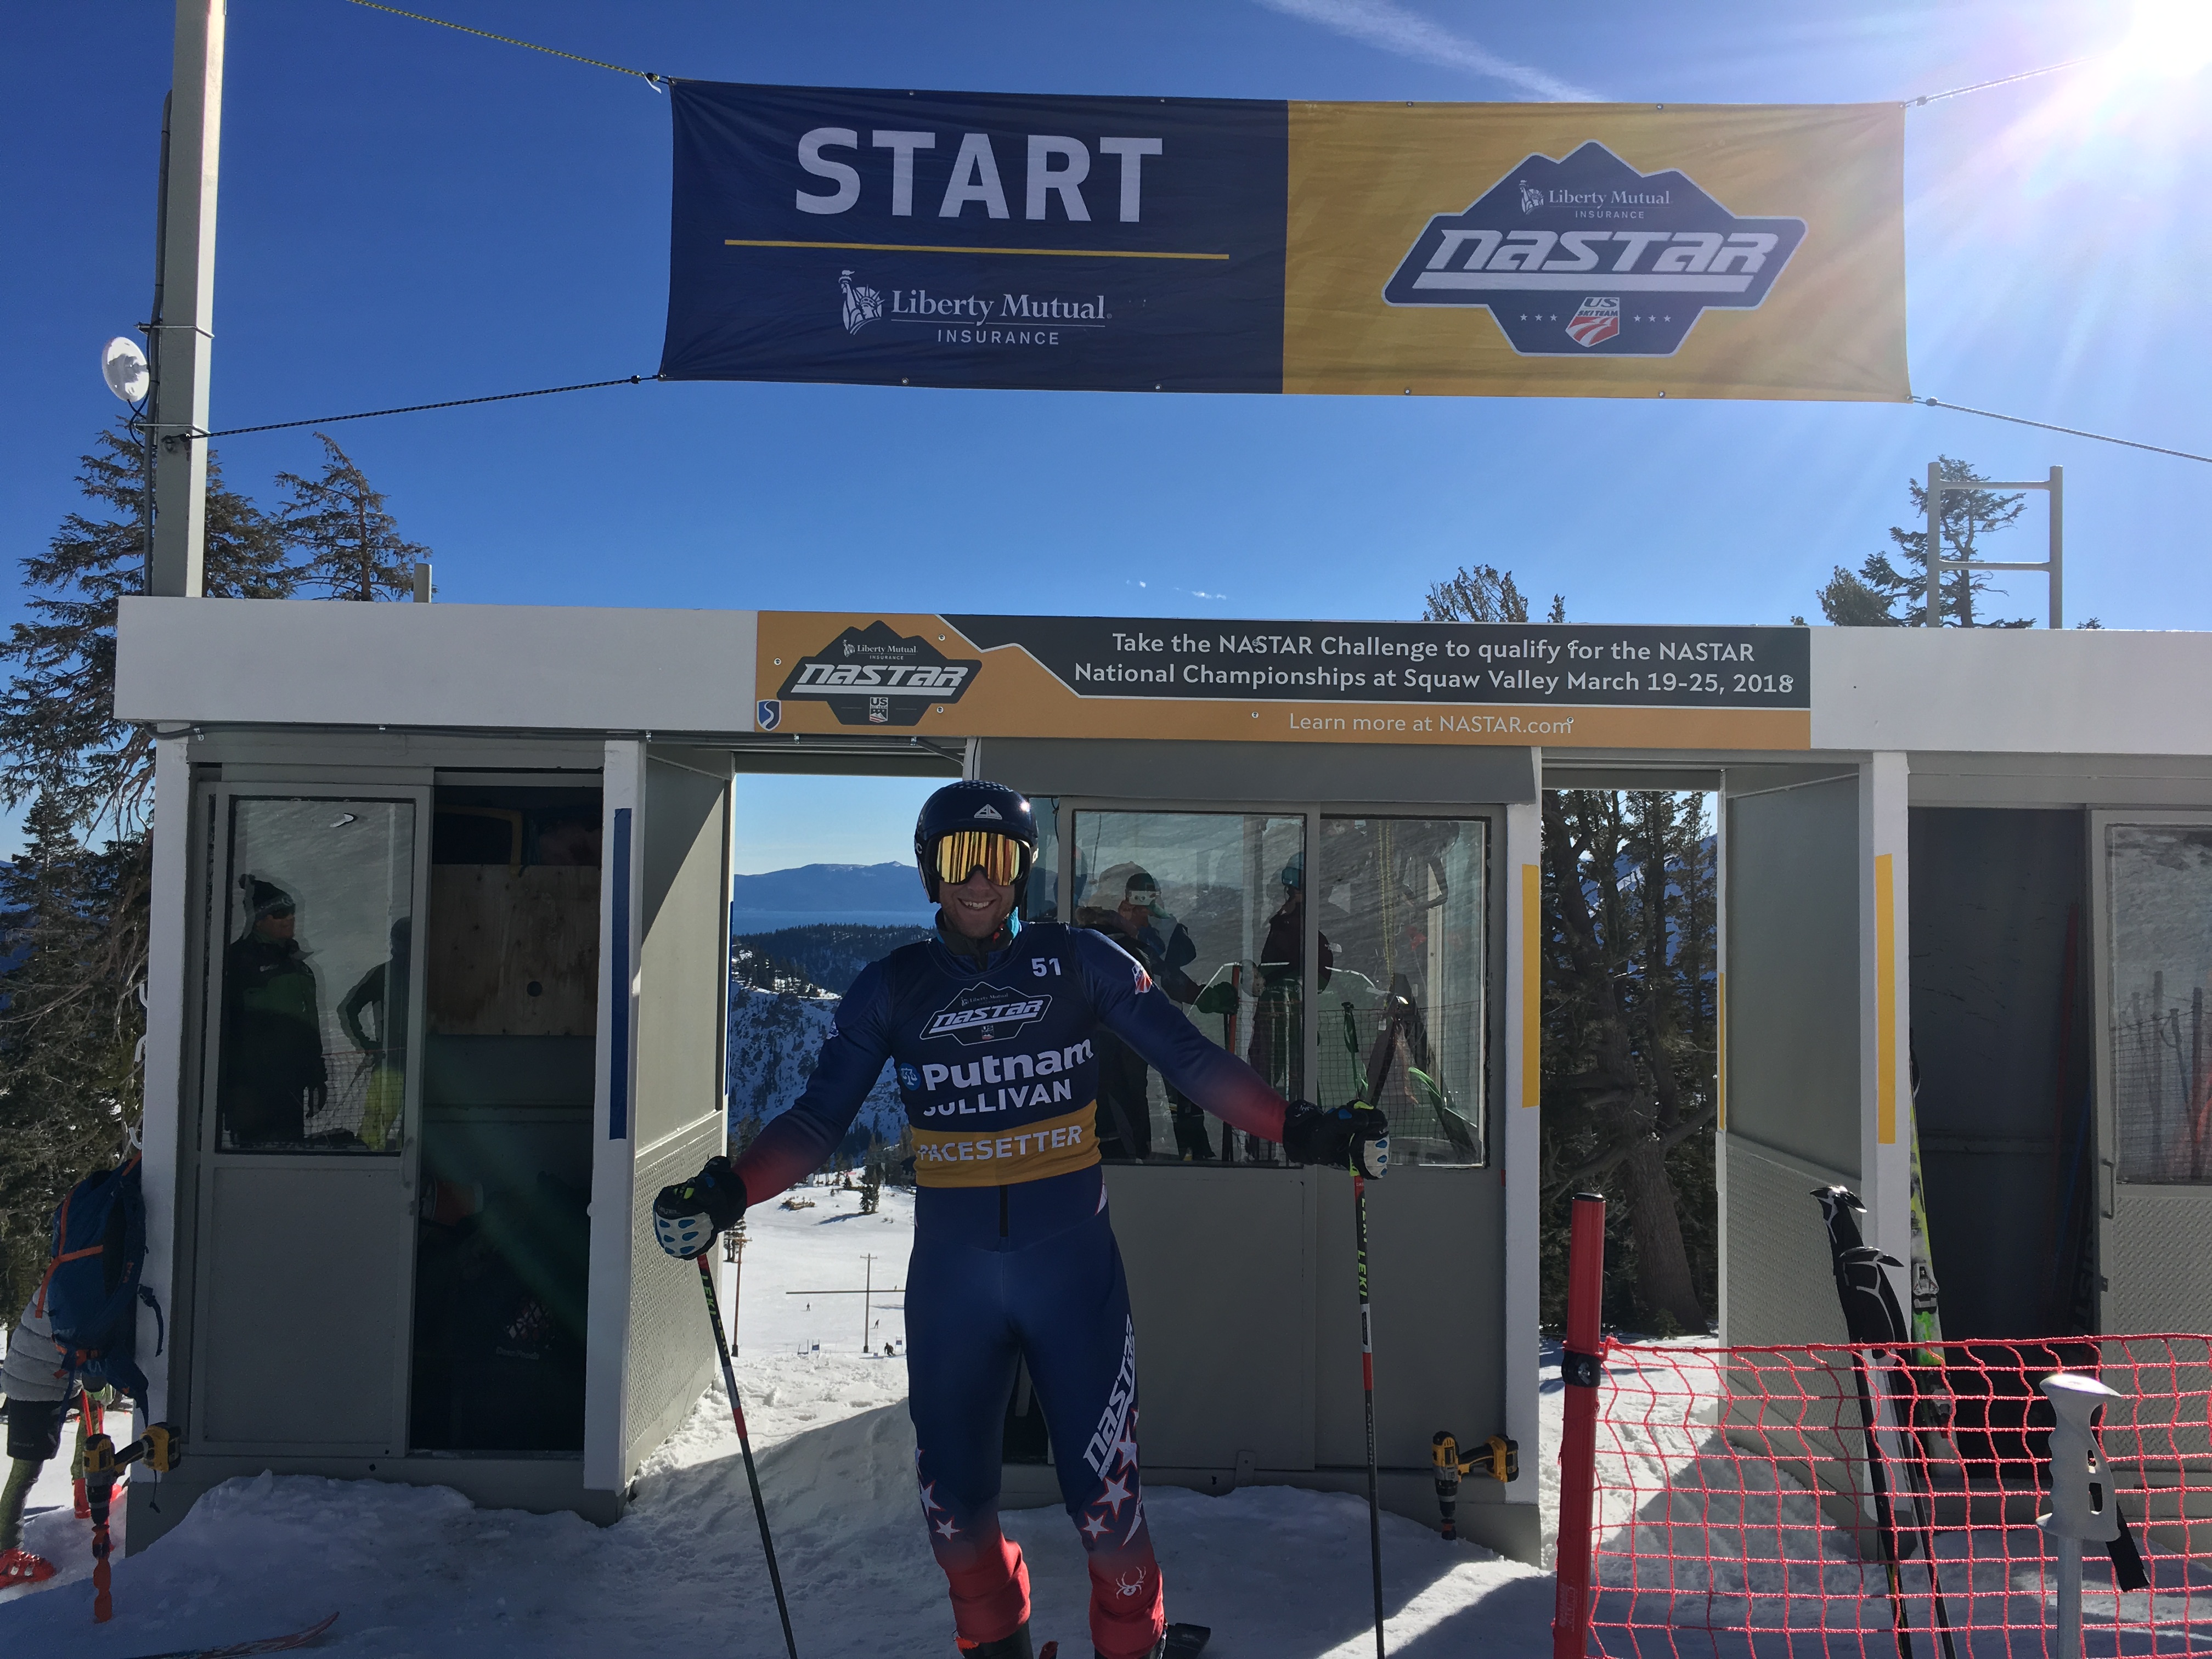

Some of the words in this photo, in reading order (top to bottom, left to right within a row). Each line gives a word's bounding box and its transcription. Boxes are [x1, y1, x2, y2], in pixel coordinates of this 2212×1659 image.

[795, 127, 1163, 222] START
[1549, 189, 1606, 208] Liberty
[1611, 191, 1670, 206] Mutual
[1575, 210, 1645, 219] INSURANCE
[891, 290, 994, 326] Liberty
[1584, 298, 1618, 307] US
[938, 329, 1059, 345] INSURANCE
[857, 645, 885, 654] Liberty
[1113, 633, 1164, 652] Take
[1171, 634, 1210, 653] the
[1220, 635, 1313, 654] NASTAR
[1321, 636, 1437, 661] Challenge
[1446, 641, 1470, 657] to
[1478, 639, 1561, 664] qualify
[1568, 641, 1604, 659] for
[1611, 641, 1650, 660] the
[1660, 642, 1754, 662] NASTAR
[1075, 663, 1175, 682] National
[1183, 664, 1366, 690] Championships
[1374, 670, 1397, 687] at
[1404, 669, 1480, 692] Squaw
[1488, 670, 1559, 694] Valley
[1567, 671, 1639, 690] March
[1647, 673, 1725, 695] 19-25,
[1733, 674, 1793, 693] 2018
[871, 698, 888, 706] US
[1290, 713, 1345, 730] Learn
[1353, 718, 1406, 731] more
[1413, 716, 1432, 731] at
[1440, 716, 1571, 733] NASTAR.com
[1031, 958, 1062, 977] 51
[922, 1039, 1093, 1091] Putnam
[1358, 1250, 1367, 1296] LEKI
